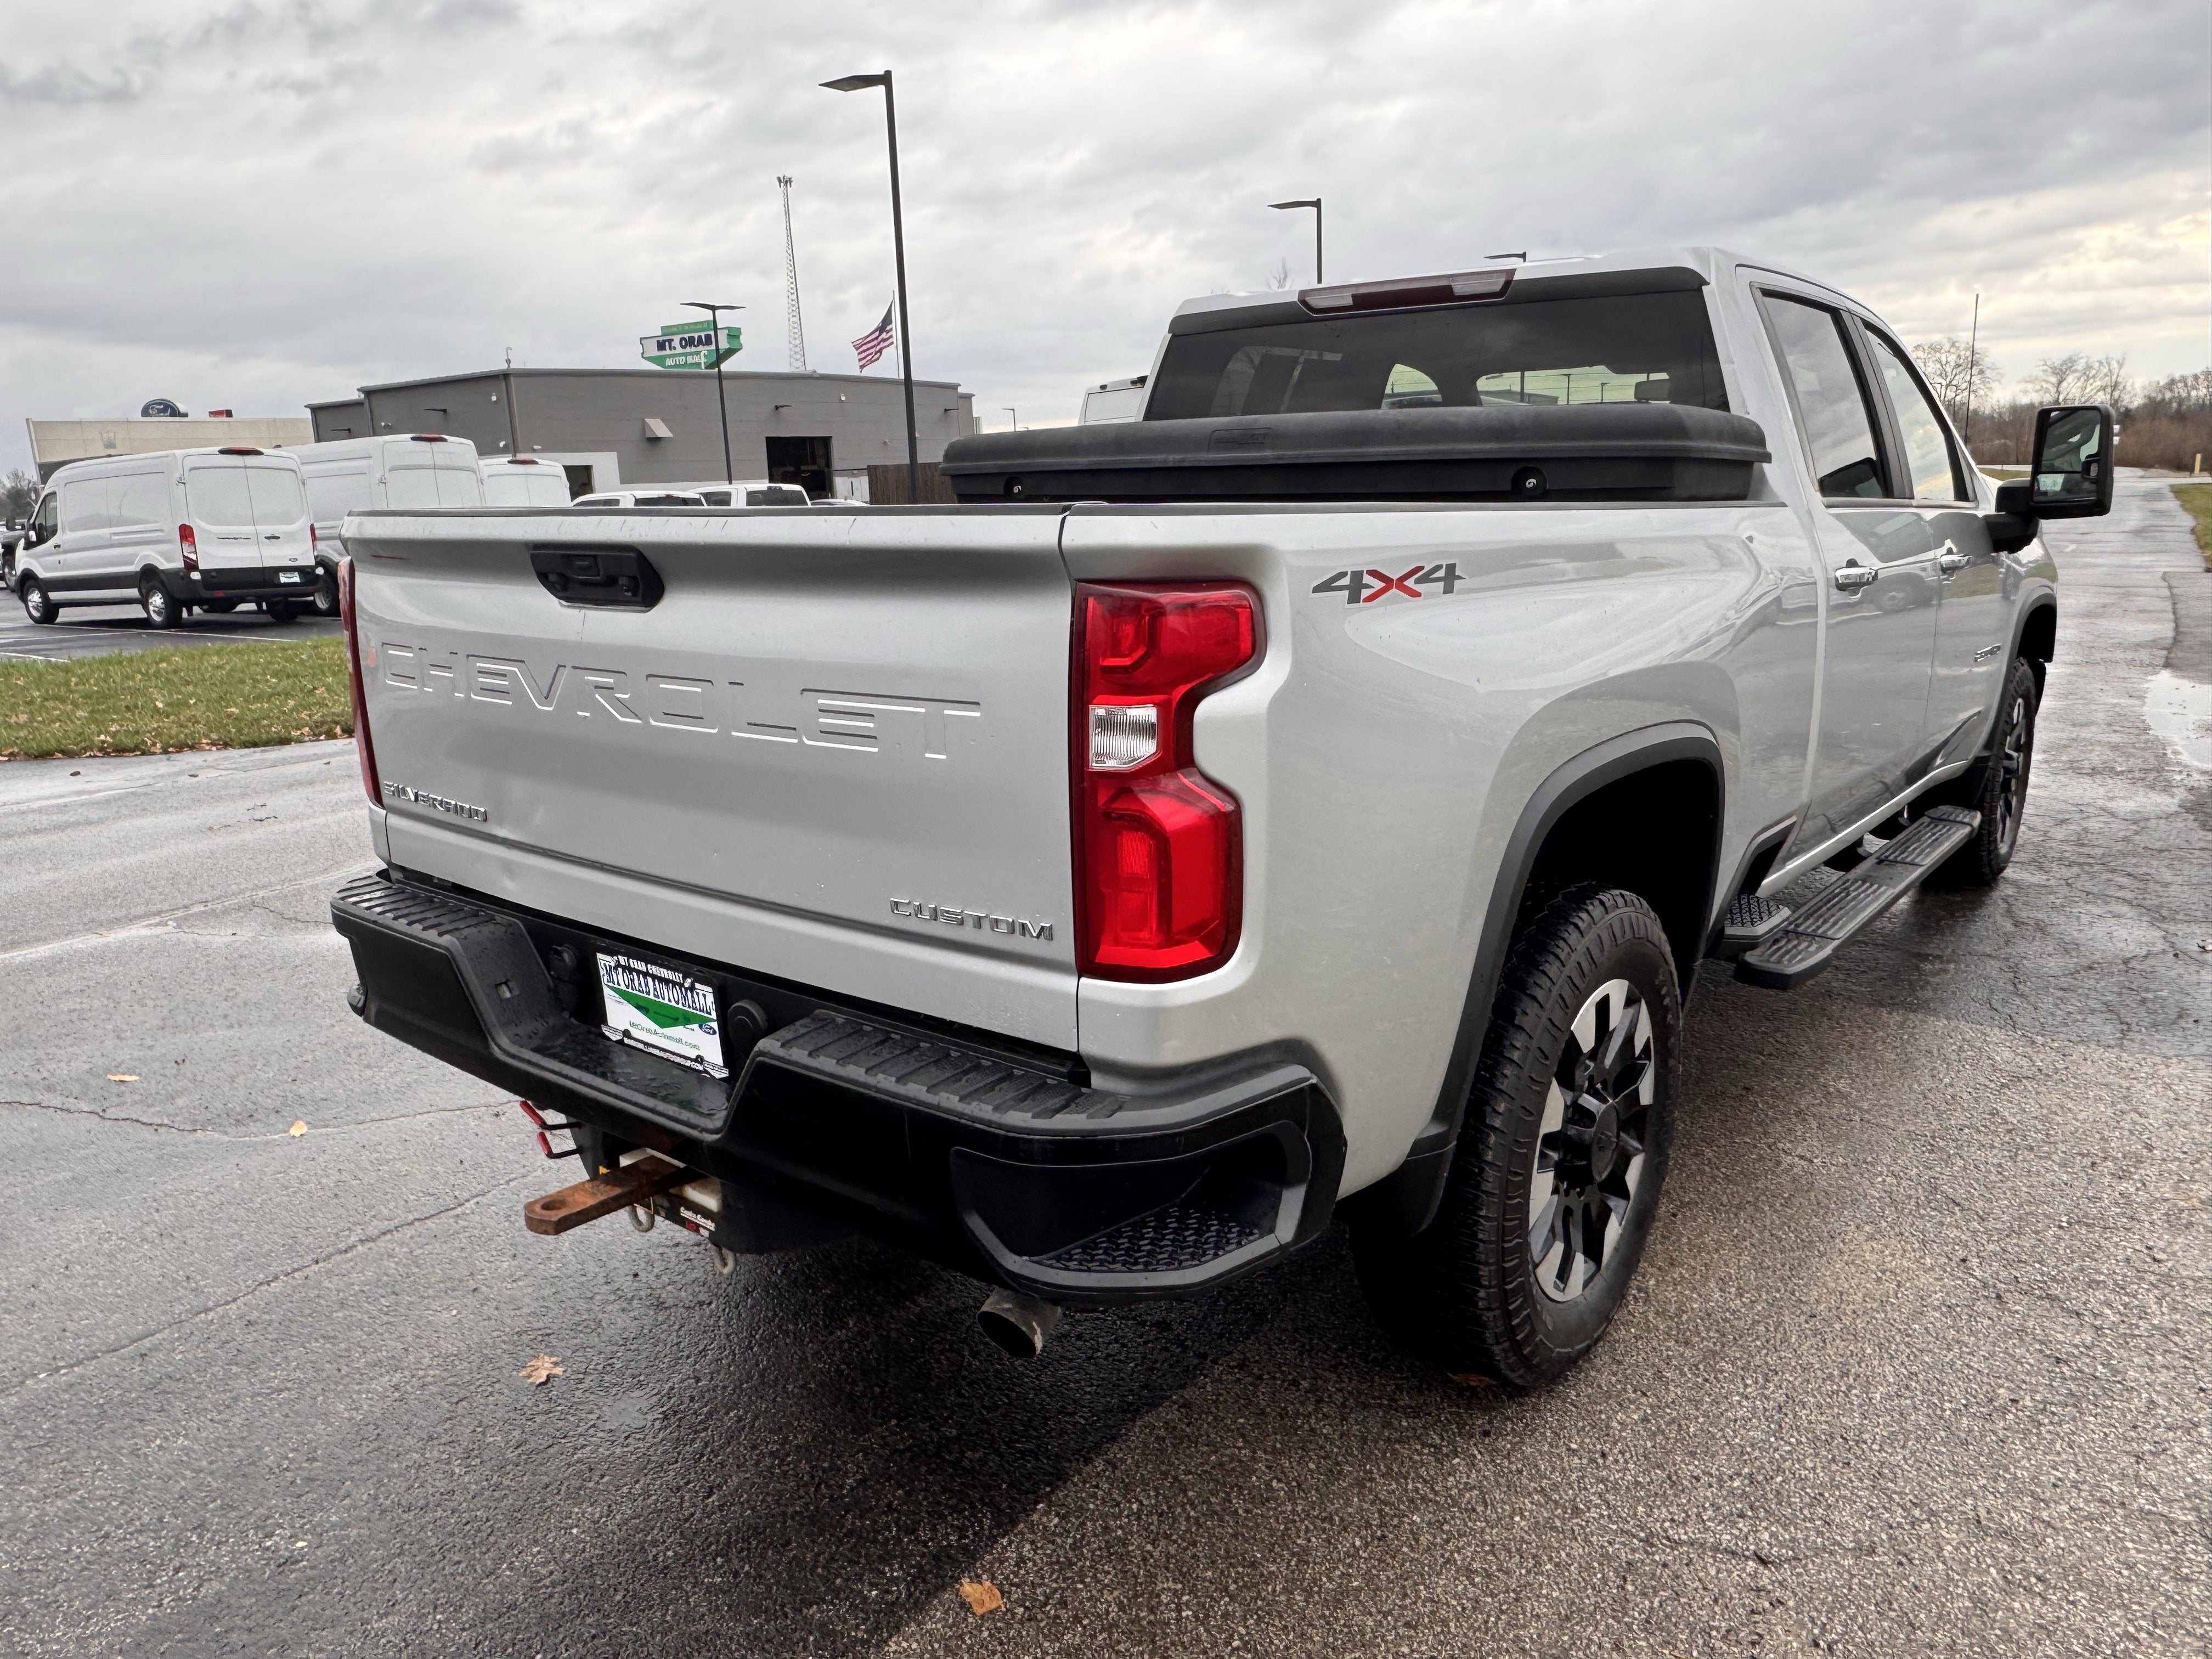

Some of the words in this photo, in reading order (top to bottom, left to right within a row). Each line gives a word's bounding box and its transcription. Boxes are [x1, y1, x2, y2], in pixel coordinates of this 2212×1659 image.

[665, 357, 686, 366] AUTO
[679, 334, 713, 349] ORAB
[1312, 563, 1466, 604] 4X4
[381, 642, 981, 759] CHEVROLET
[383, 781, 487, 822] SILVERADO
[889, 898, 1053, 941] CUSTOM
